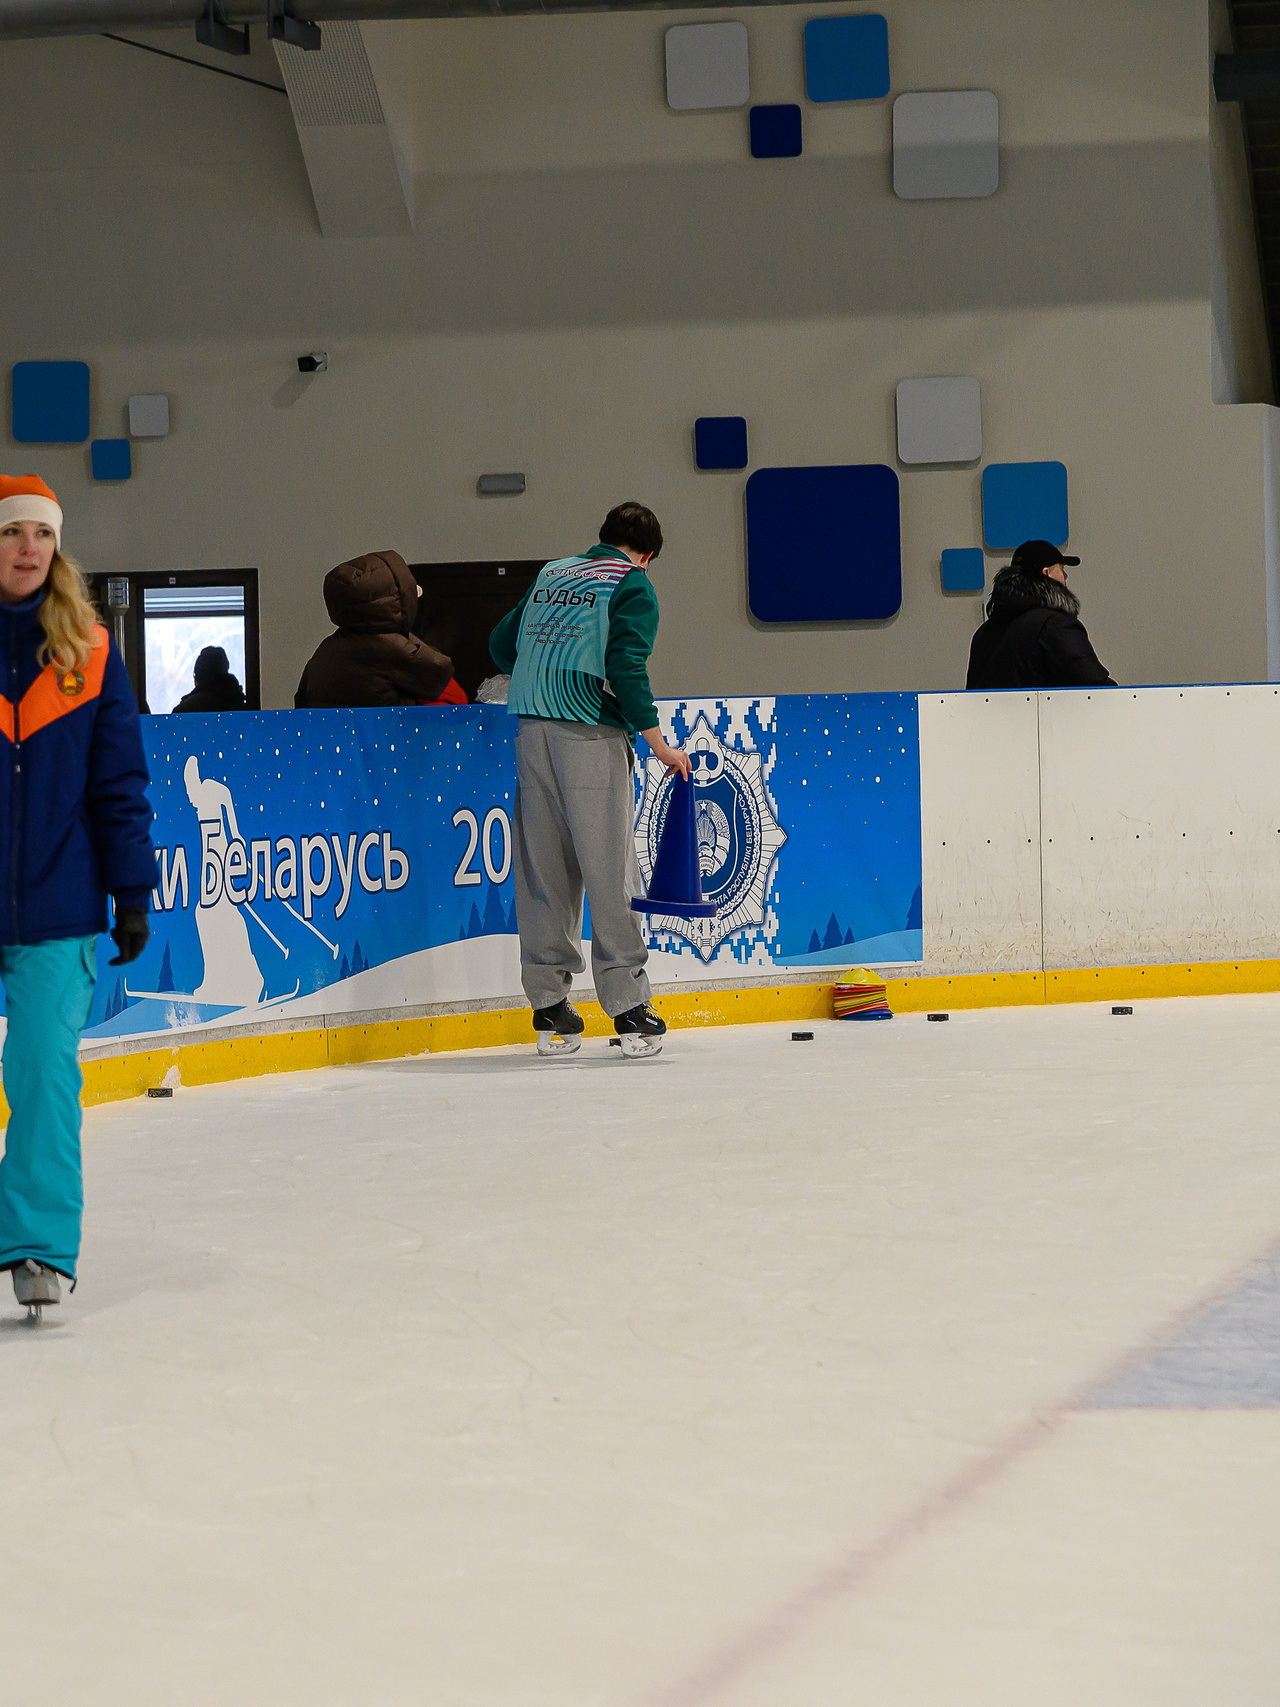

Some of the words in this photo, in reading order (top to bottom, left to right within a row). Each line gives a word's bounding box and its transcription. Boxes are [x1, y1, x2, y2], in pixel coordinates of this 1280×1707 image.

[533, 588, 597, 609] СУДЬЯ
[738, 794, 752, 844] БЕЛАРУСЬ
[199, 817, 411, 919] Беларусь
